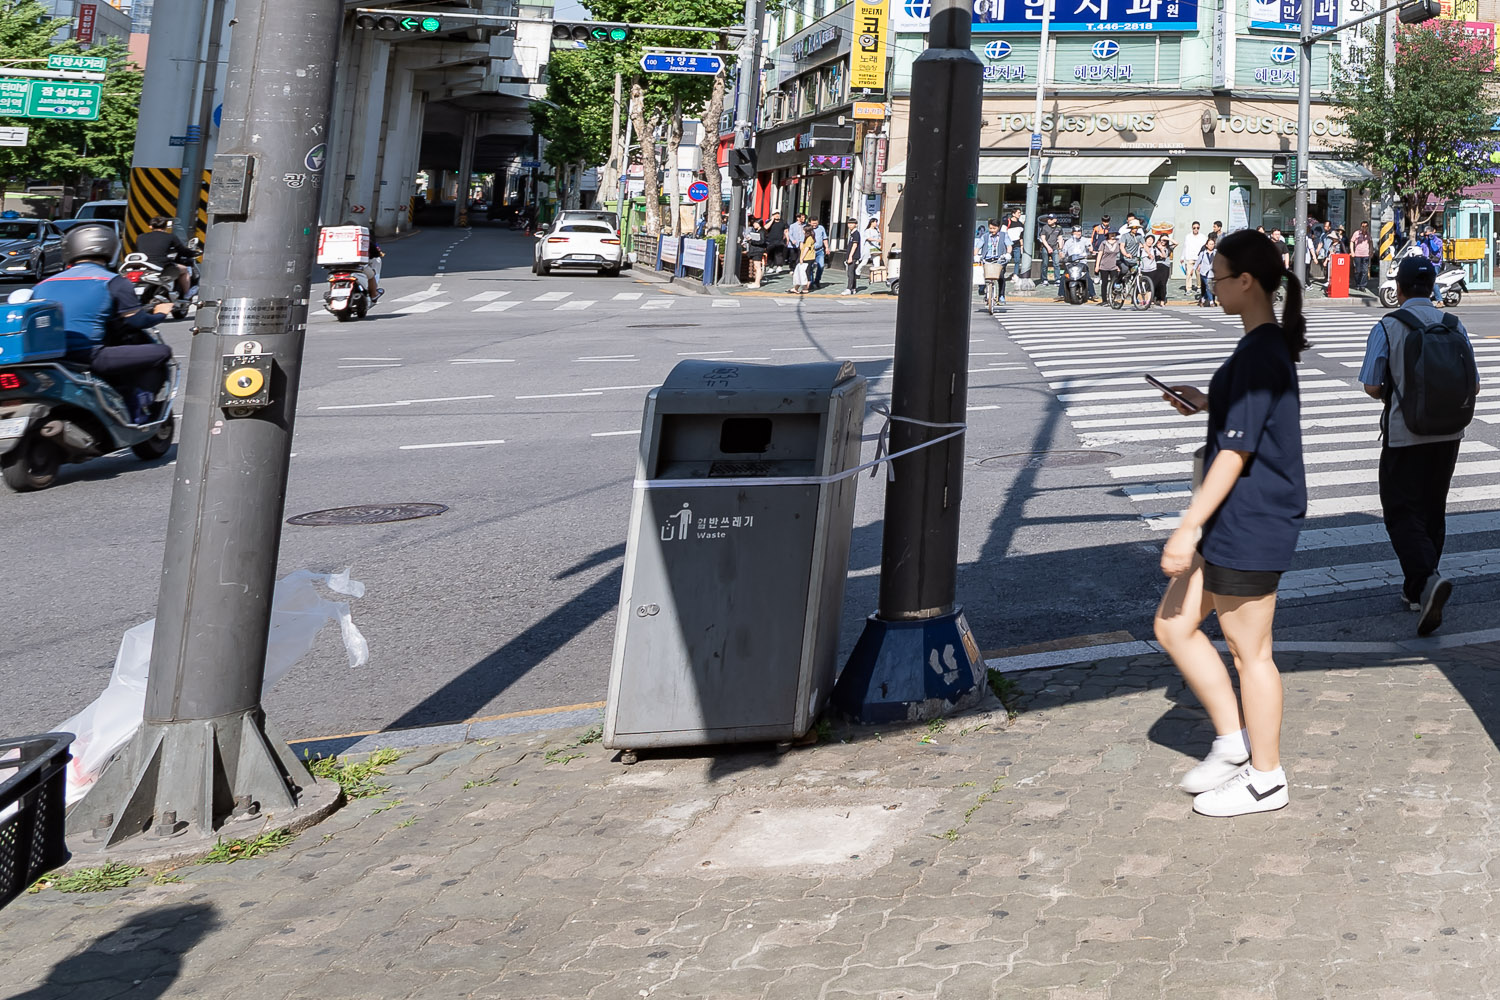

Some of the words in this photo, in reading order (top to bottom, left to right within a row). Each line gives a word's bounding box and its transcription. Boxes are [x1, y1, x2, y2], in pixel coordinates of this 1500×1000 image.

[1086, 22, 1153, 30] T.446-2818
[51, 57, 103, 68] 자양사거리
[665, 56, 697, 66] 자양로
[860, 55, 878, 63] 노래
[1074, 65, 1133, 79] 혜민치과
[0, 83, 28, 92] 터미널
[41, 87, 92, 98] 잠실대교
[998, 113, 1054, 132] TOUS
[1058, 113, 1086, 132] les
[1086, 112, 1156, 136] JOURS
[1217, 114, 1274, 134] TOUS
[697, 515, 754, 530] 일반쓰레기
[696, 531, 726, 539] Waste
